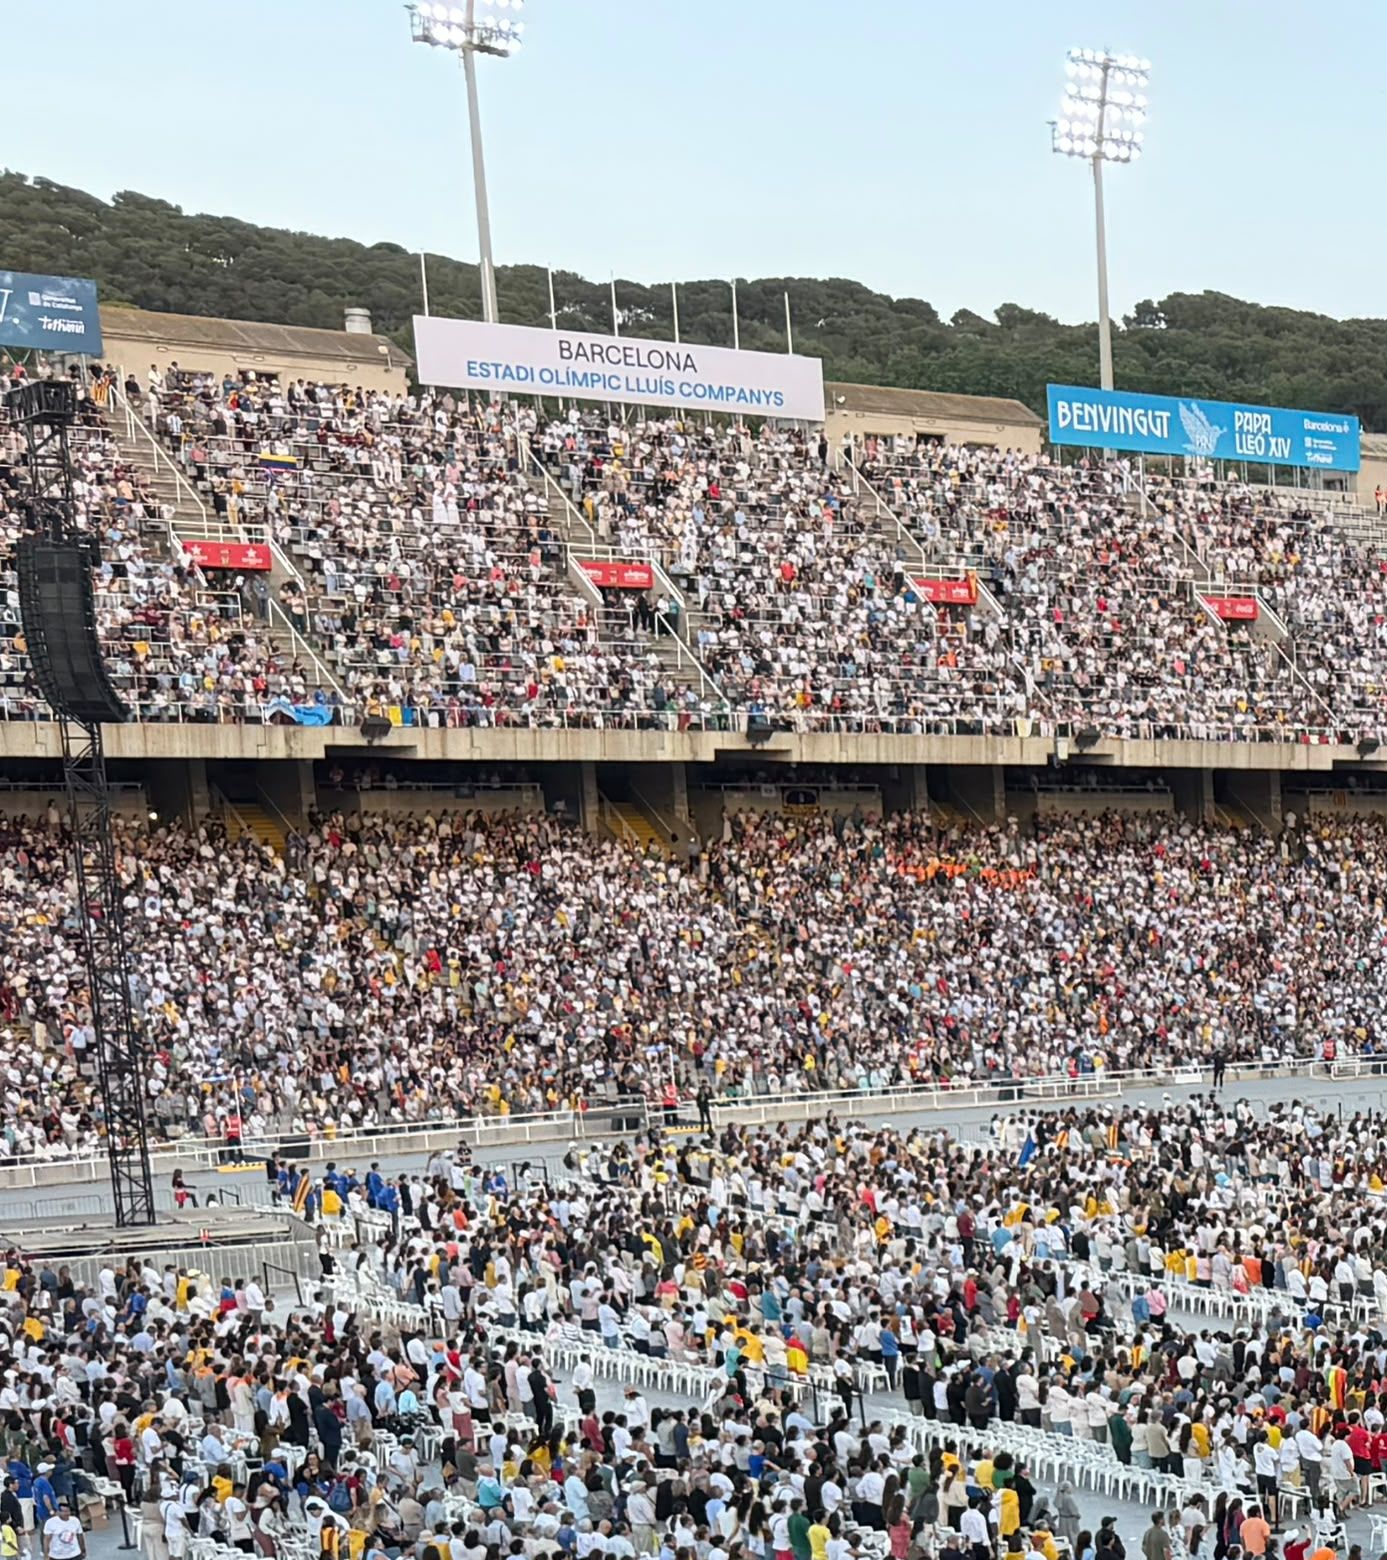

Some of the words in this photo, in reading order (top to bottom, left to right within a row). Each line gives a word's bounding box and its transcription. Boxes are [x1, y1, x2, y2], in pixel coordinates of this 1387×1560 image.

[558, 339, 698, 373] BARCELONA
[466, 360, 535, 383] ESTADI
[539, 366, 621, 391] OLÍMPIC
[625, 375, 675, 397] LLUÍS
[679, 381, 784, 408] COMPANYS
[1057, 400, 1171, 439] BENVINGUT
[1234, 410, 1272, 435] PAPA
[1303, 418, 1342, 433] Barcelona
[1234, 432, 1264, 456] LLEÓ
[1269, 437, 1291, 459] XIV
